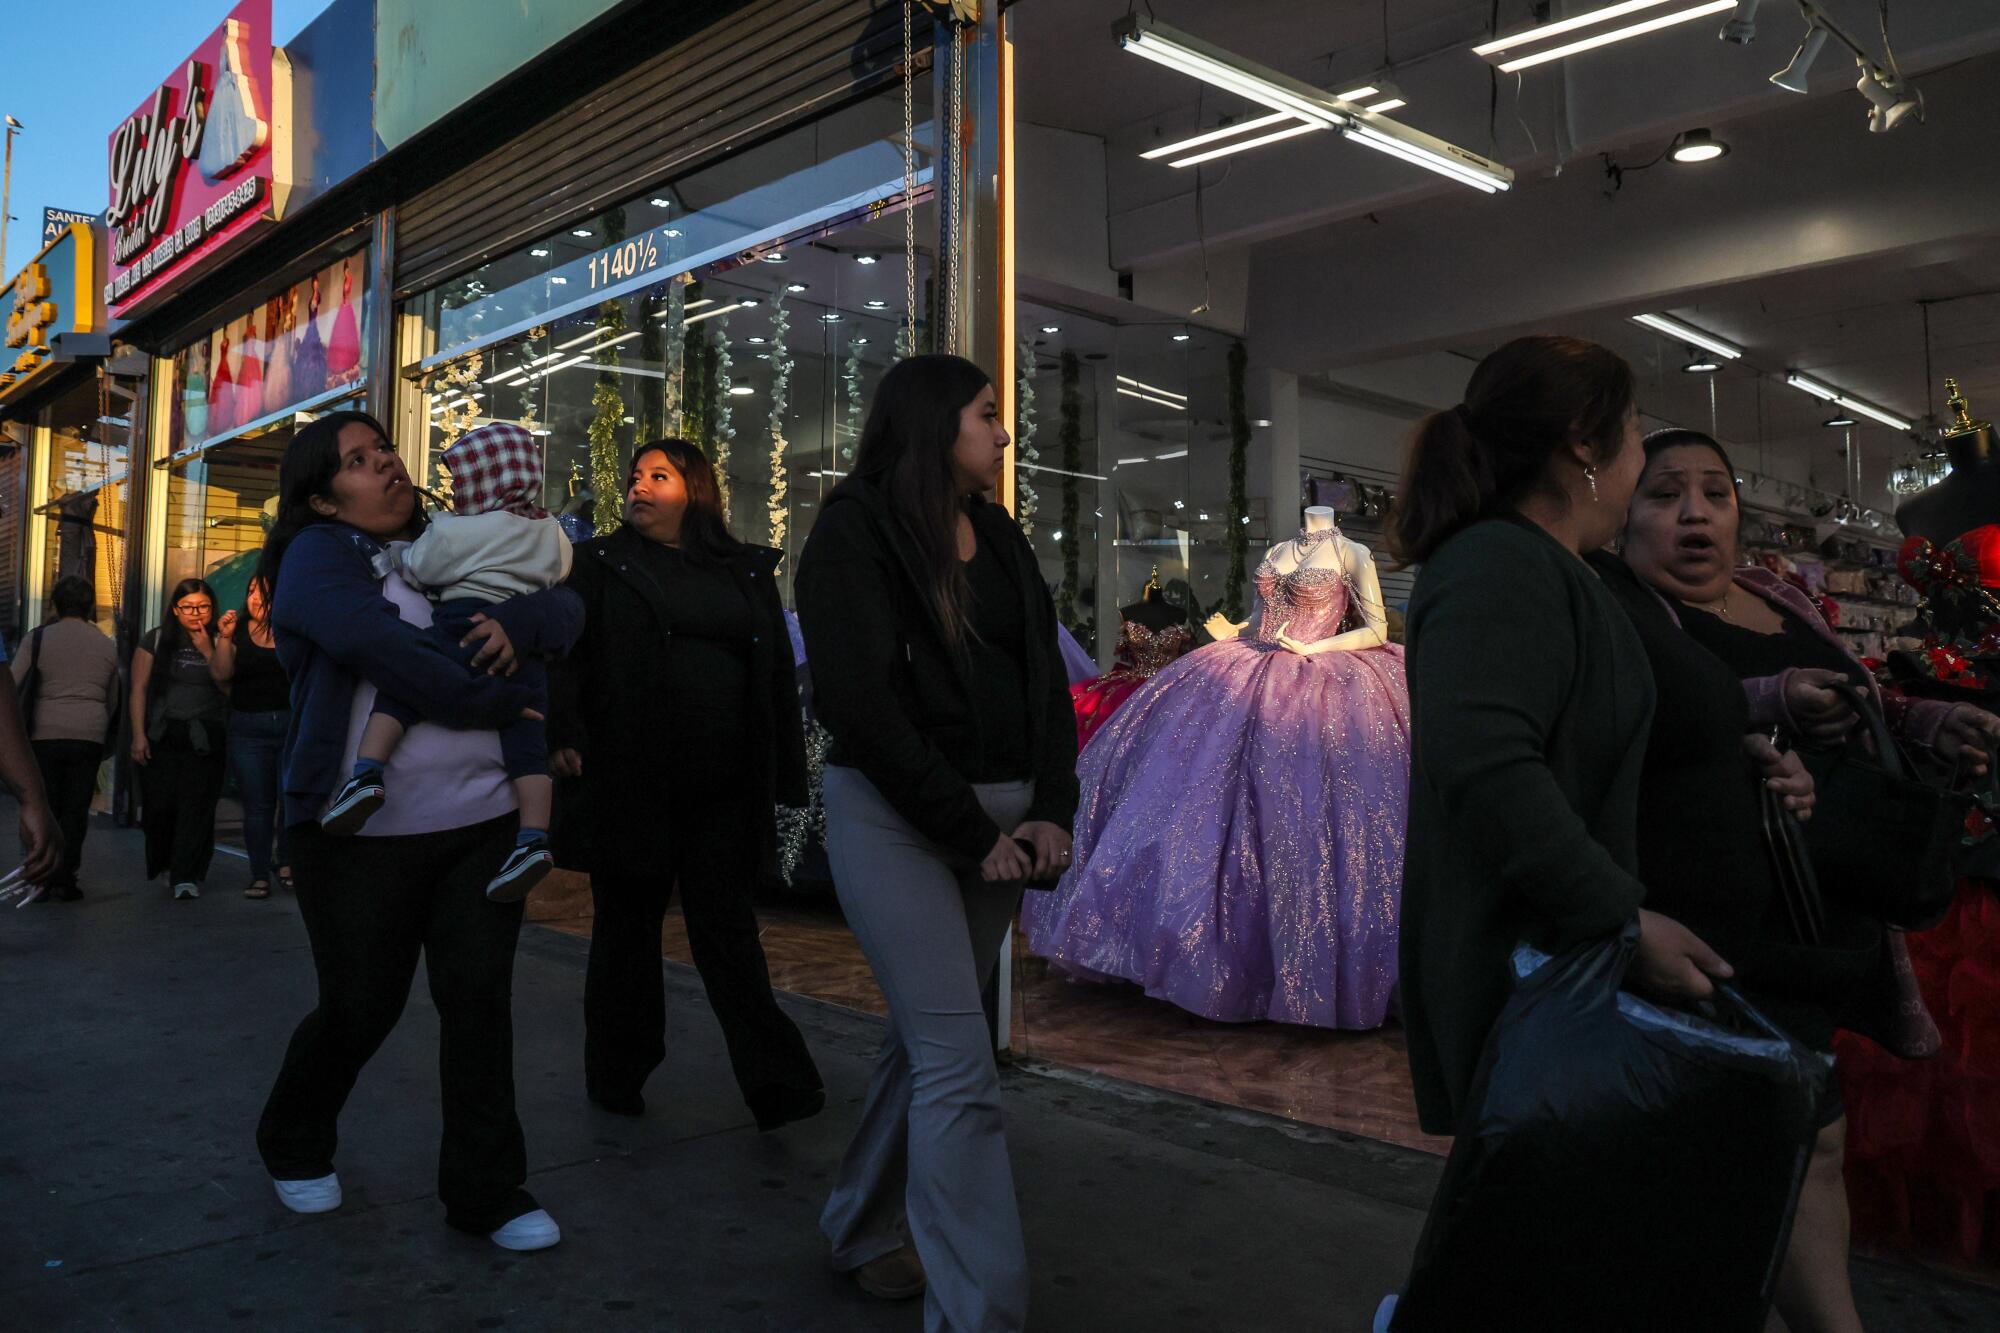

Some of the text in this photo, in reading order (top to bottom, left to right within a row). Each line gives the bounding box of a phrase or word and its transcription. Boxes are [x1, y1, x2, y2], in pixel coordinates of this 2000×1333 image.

[106, 59, 203, 234] Lily's
[111, 204, 149, 265] Bridal
[114, 268, 131, 299] MAPLE
[130, 259, 142, 287] AVE
[141, 251, 153, 278] LOS
[152, 234, 174, 270] ANGELES
[174, 228, 184, 254] CA
